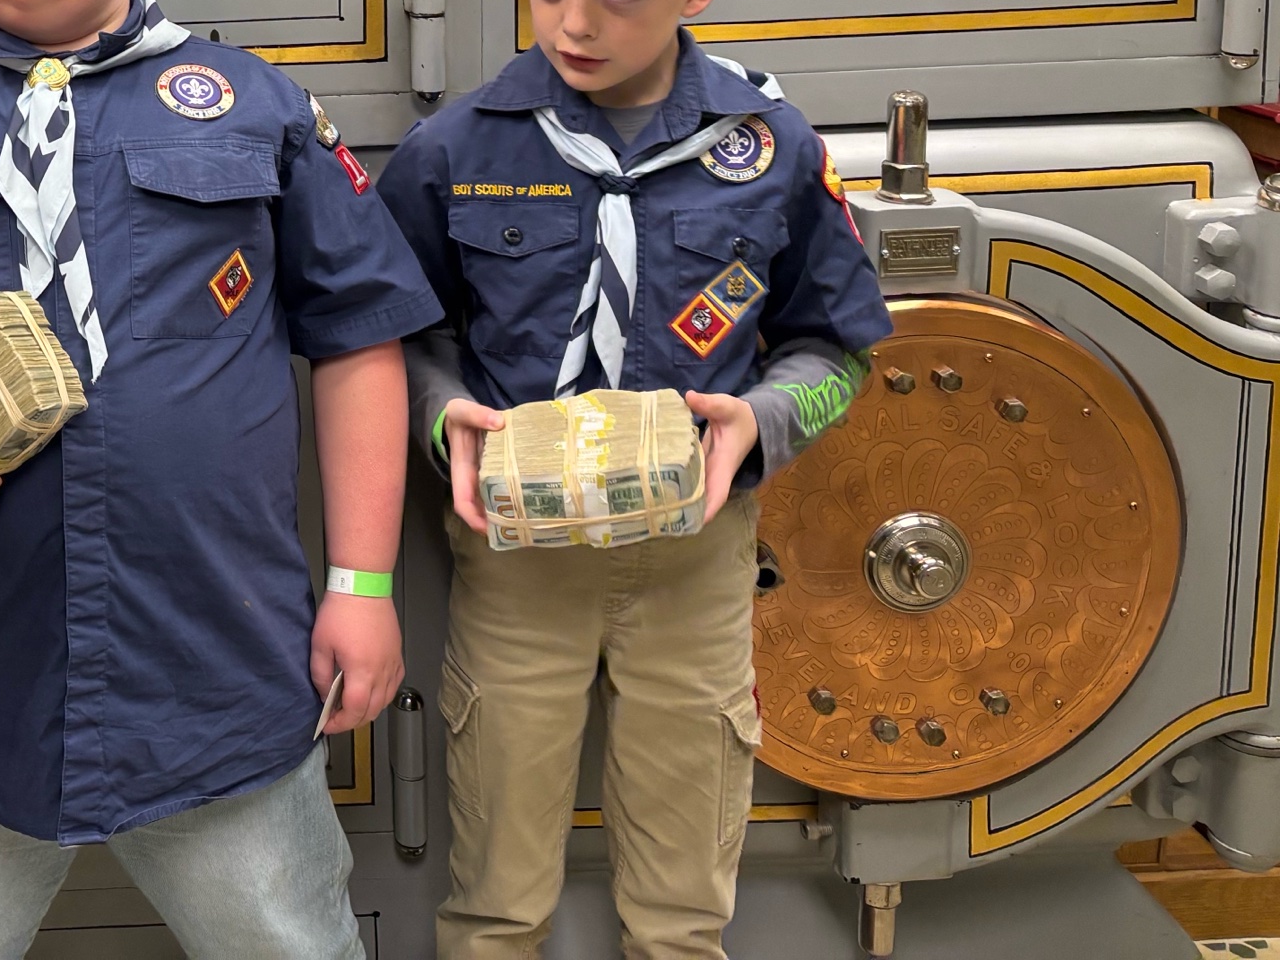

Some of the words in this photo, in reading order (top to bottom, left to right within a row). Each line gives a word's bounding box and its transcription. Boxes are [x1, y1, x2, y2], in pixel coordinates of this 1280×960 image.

[452, 183, 473, 196] BOY
[474, 183, 514, 197] SCOUTS
[516, 187, 528, 195] OF
[528, 183, 573, 197] AMERICA
[938, 405, 1029, 460] SAFE
[1024, 459, 1054, 488] &
[1042, 493, 1079, 608] LOCK
